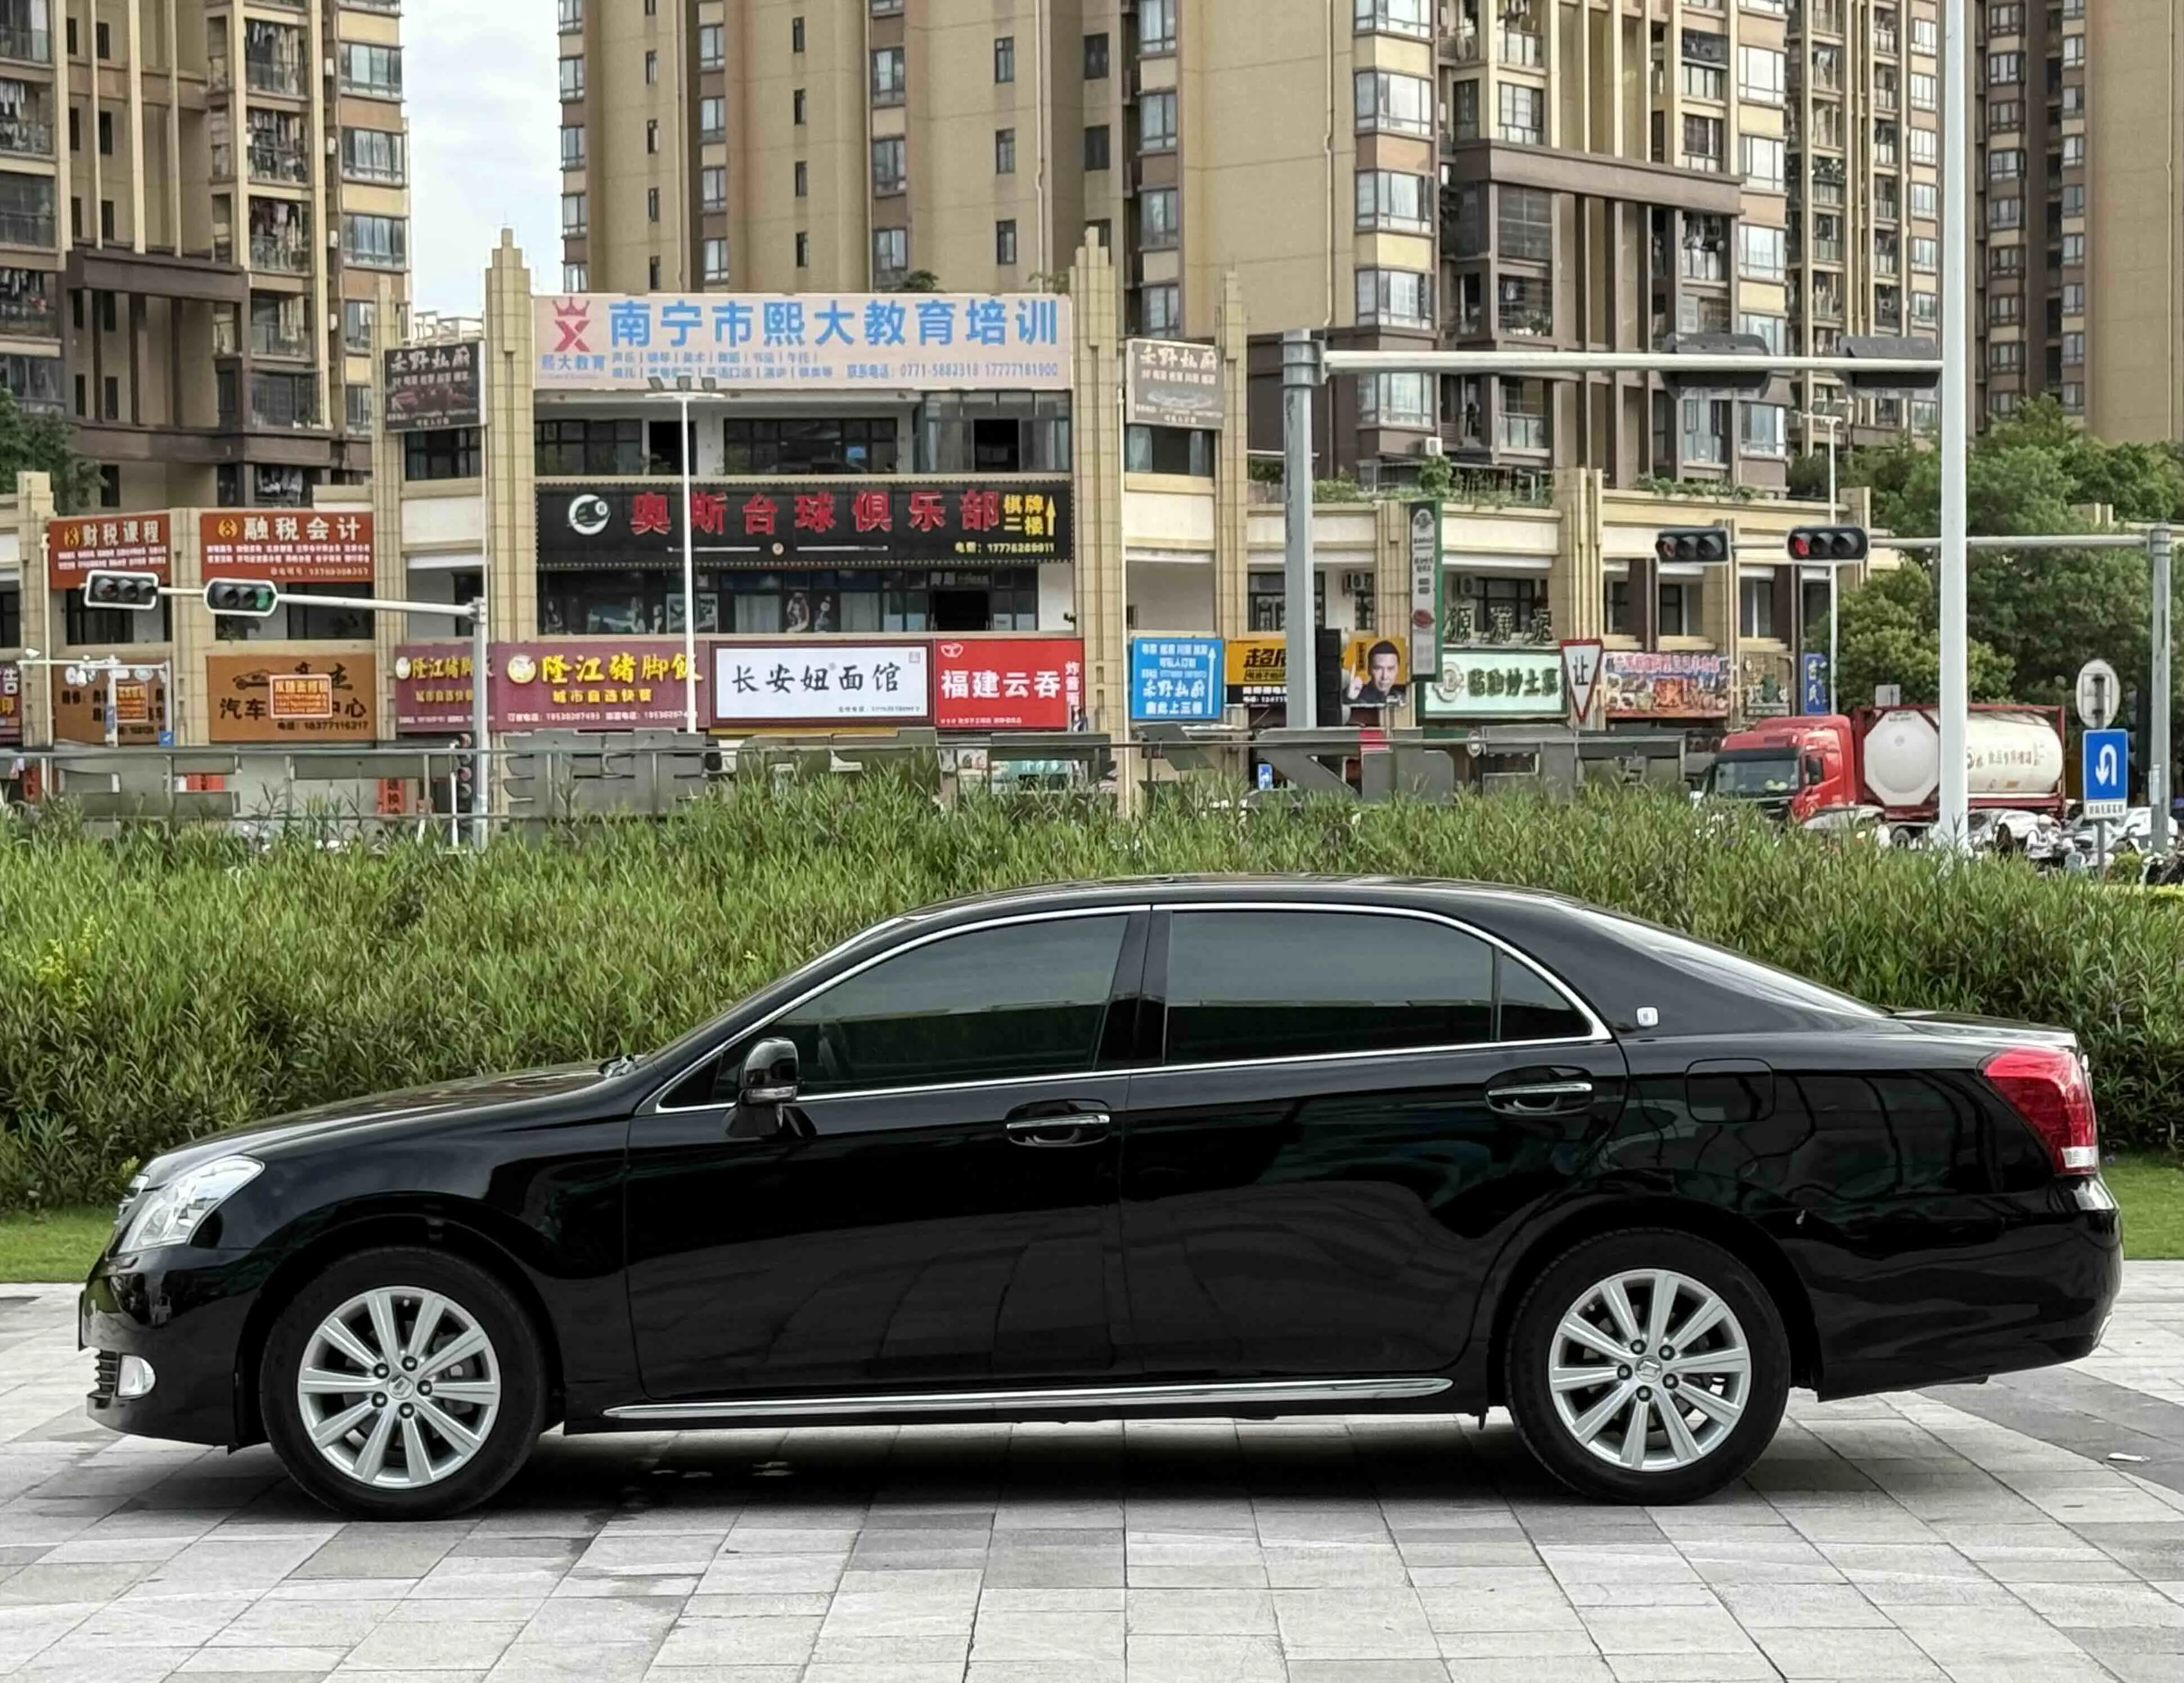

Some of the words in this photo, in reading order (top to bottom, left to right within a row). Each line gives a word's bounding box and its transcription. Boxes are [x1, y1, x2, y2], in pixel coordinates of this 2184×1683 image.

[609, 299, 1058, 348] 南宁市熙大教育培训
[630, 489, 999, 536] 奥斯台球俱乐部
[243, 516, 361, 541] 融税会计
[731, 661, 902, 695] 长安妞面馆
[940, 670, 1062, 699] 福建云吞
[219, 697, 267, 721] 汽车
